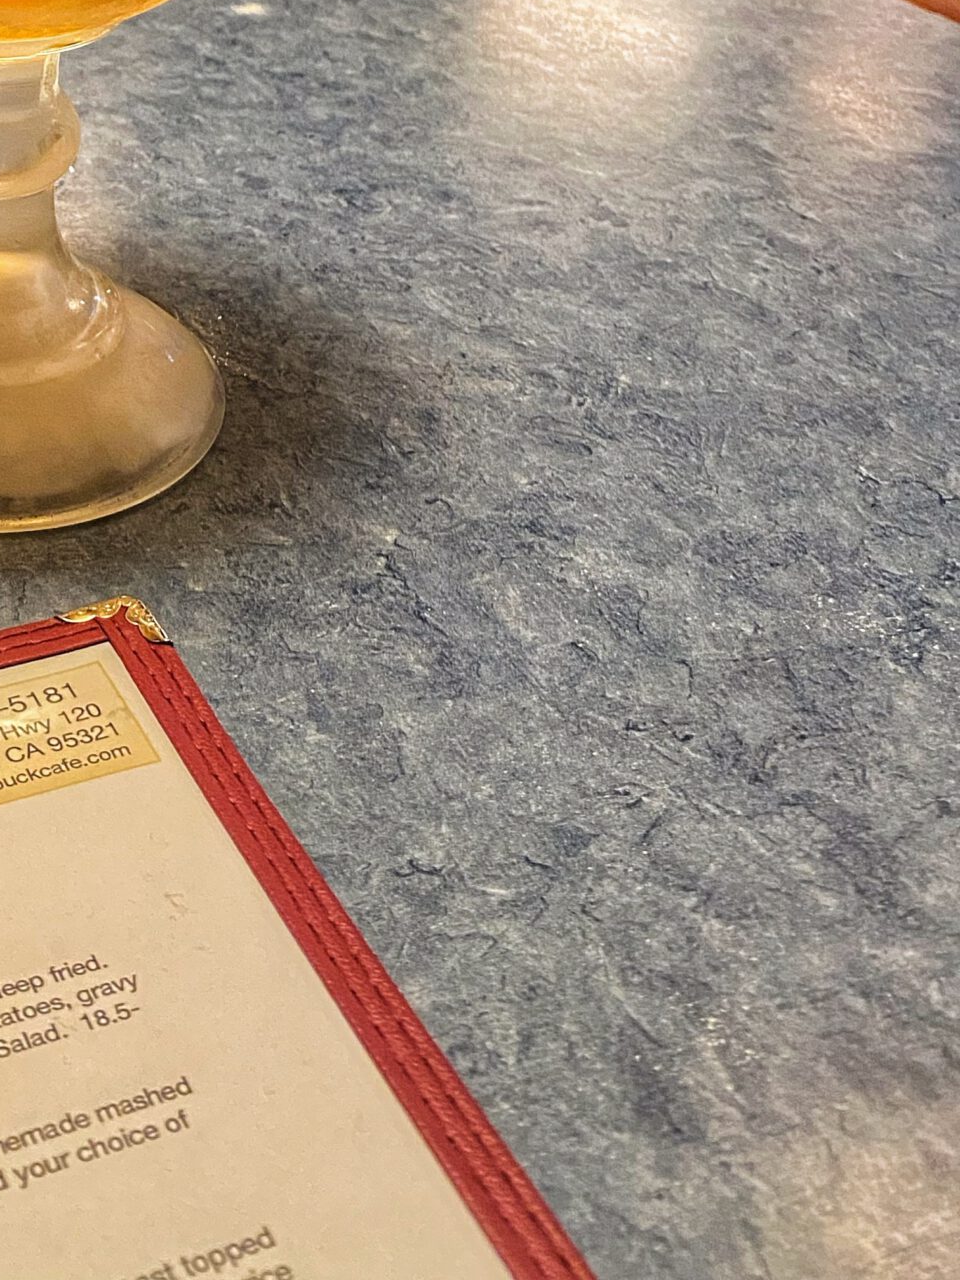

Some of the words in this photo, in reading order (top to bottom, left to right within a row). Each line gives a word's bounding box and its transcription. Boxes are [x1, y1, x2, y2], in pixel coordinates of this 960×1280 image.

[0, 718, 51, 742] Hwy
[59, 703, 102, 725] 120
[5, 743, 45, 764] CA
[47, 722, 120, 752] 95321
[49, 954, 109, 984] fried.
[77, 973, 138, 1007] gravy
[79, 1003, 140, 1031] 18.5-
[94, 1076, 193, 1123] mashed
[11, 1151, 70, 1189] your
[76, 1127, 162, 1163] choice
[164, 1108, 190, 1134] of
[180, 1226, 276, 1277] topped
